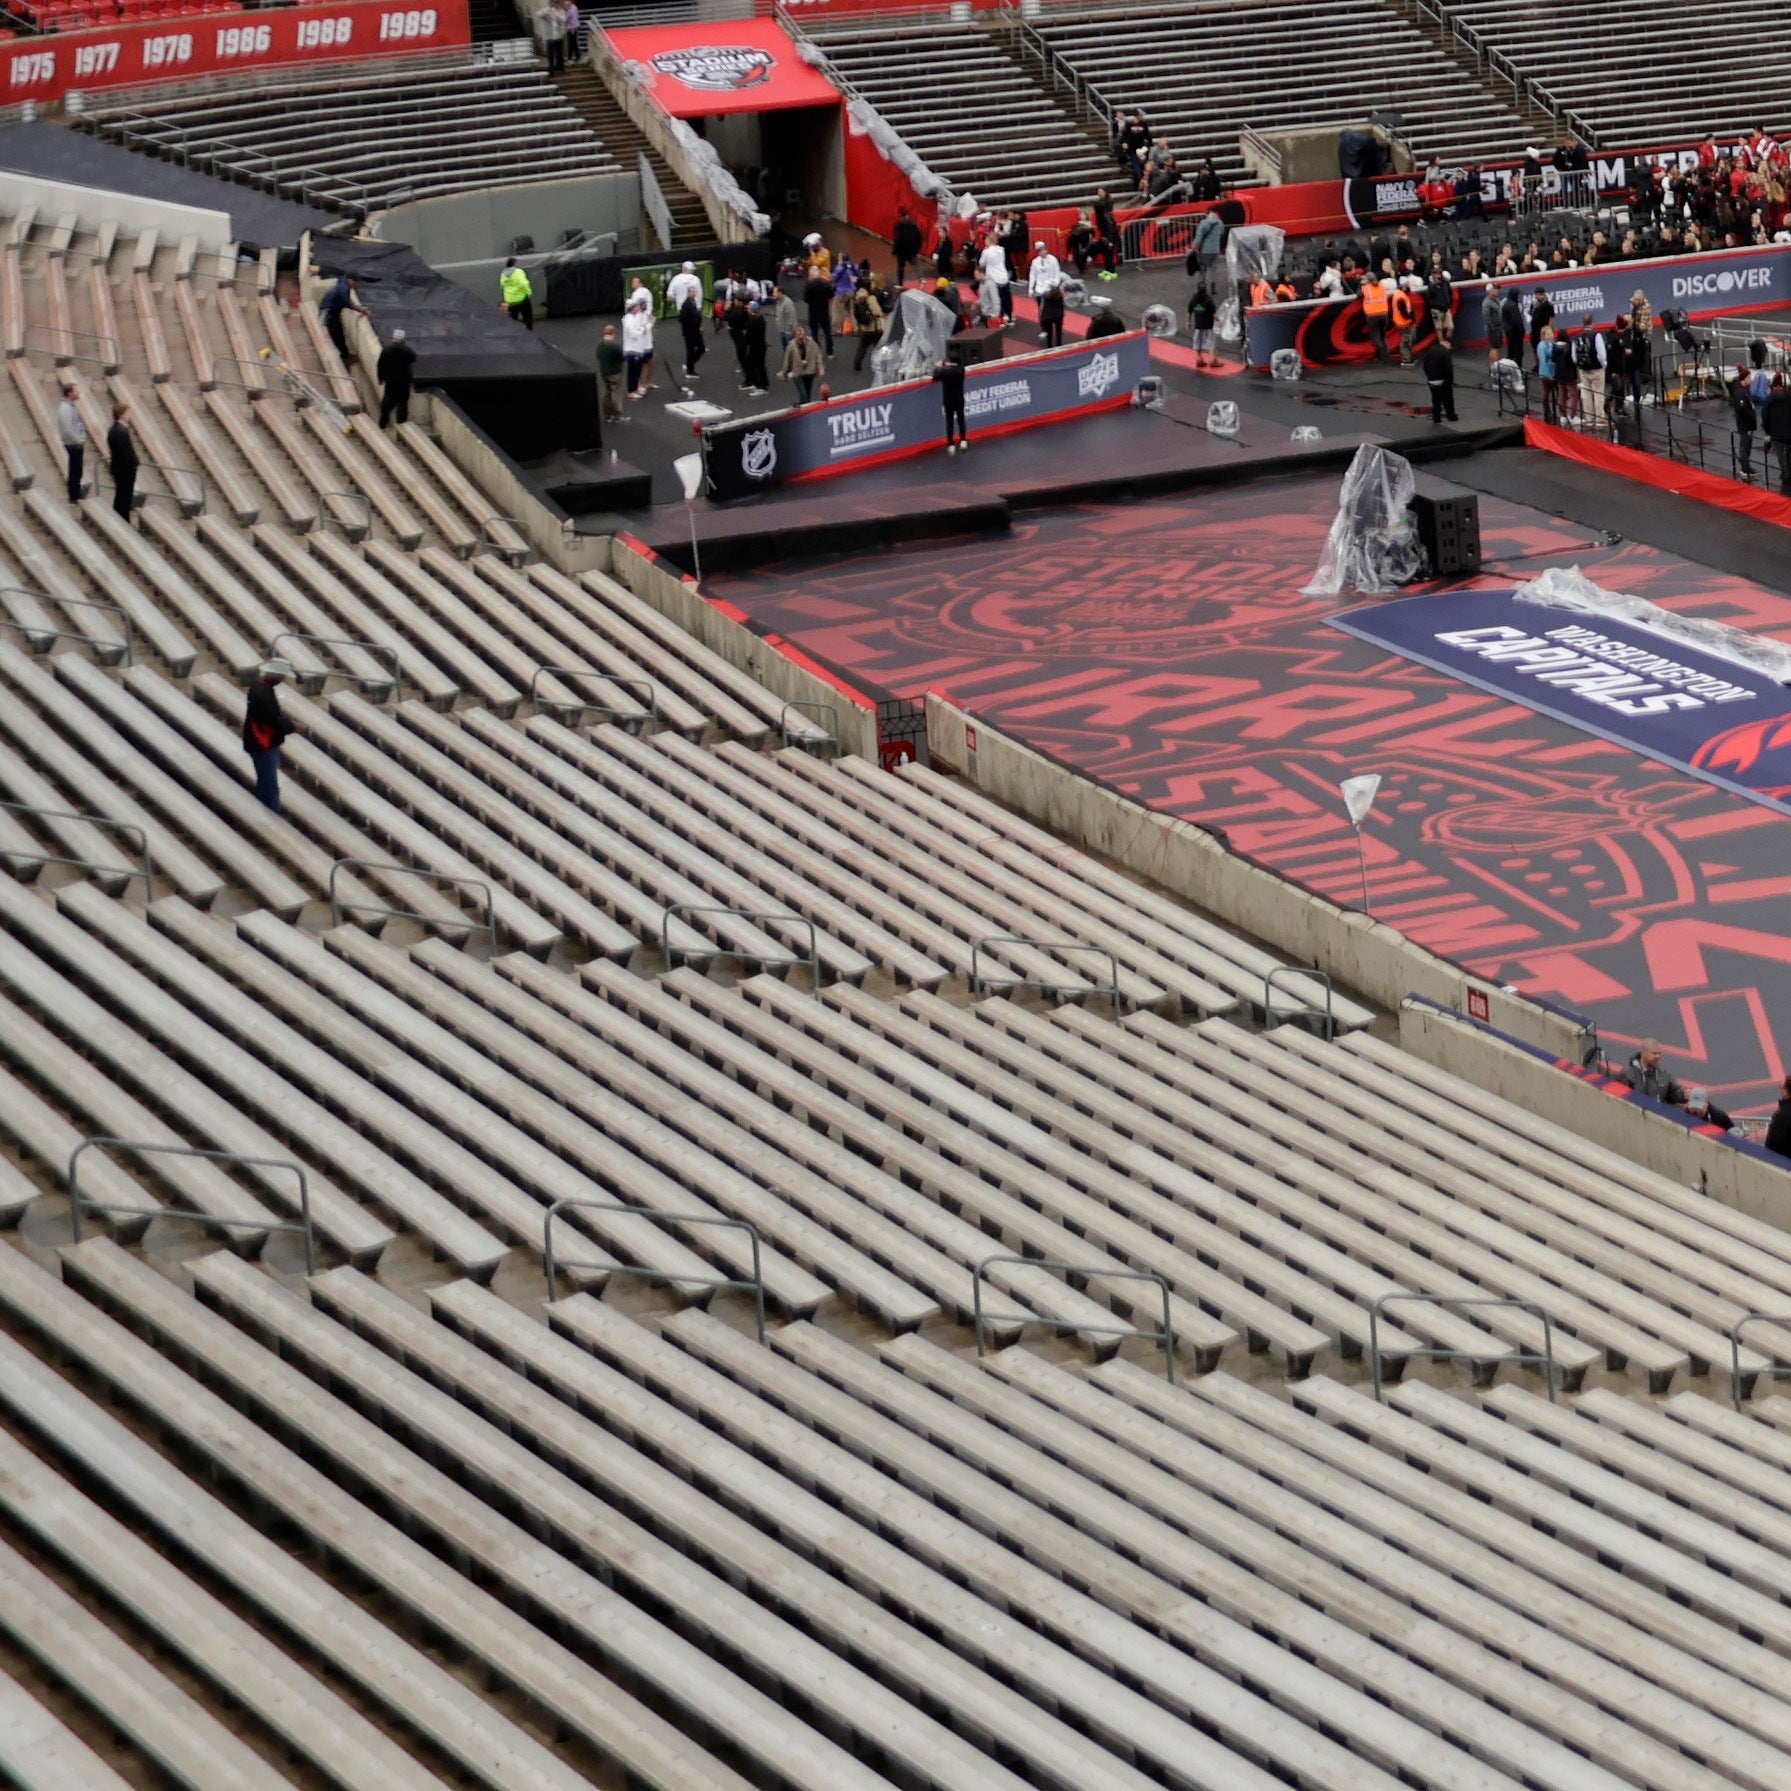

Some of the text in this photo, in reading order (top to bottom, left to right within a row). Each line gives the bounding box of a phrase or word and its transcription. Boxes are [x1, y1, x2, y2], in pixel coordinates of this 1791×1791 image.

[216, 25, 271, 57] 1986
[297, 16, 353, 48] 1988
[380, 9, 437, 41] 1989
[75, 43, 120, 76] 1977
[143, 33, 194, 67] 1978
[653, 52, 770, 73] STADIUM
[11, 51, 55, 87] 1975
[1556, 286, 1602, 300] FEDERAL
[1673, 267, 1772, 297] DISCOVER
[1566, 298, 1604, 311] UNION
[990, 379, 1030, 399] FEDERAL
[1000, 392, 1031, 410] UNION
[827, 403, 894, 437] TRULY
[1434, 624, 1708, 718] CAPITALS
[1544, 623, 1757, 704] WASHINGTON
